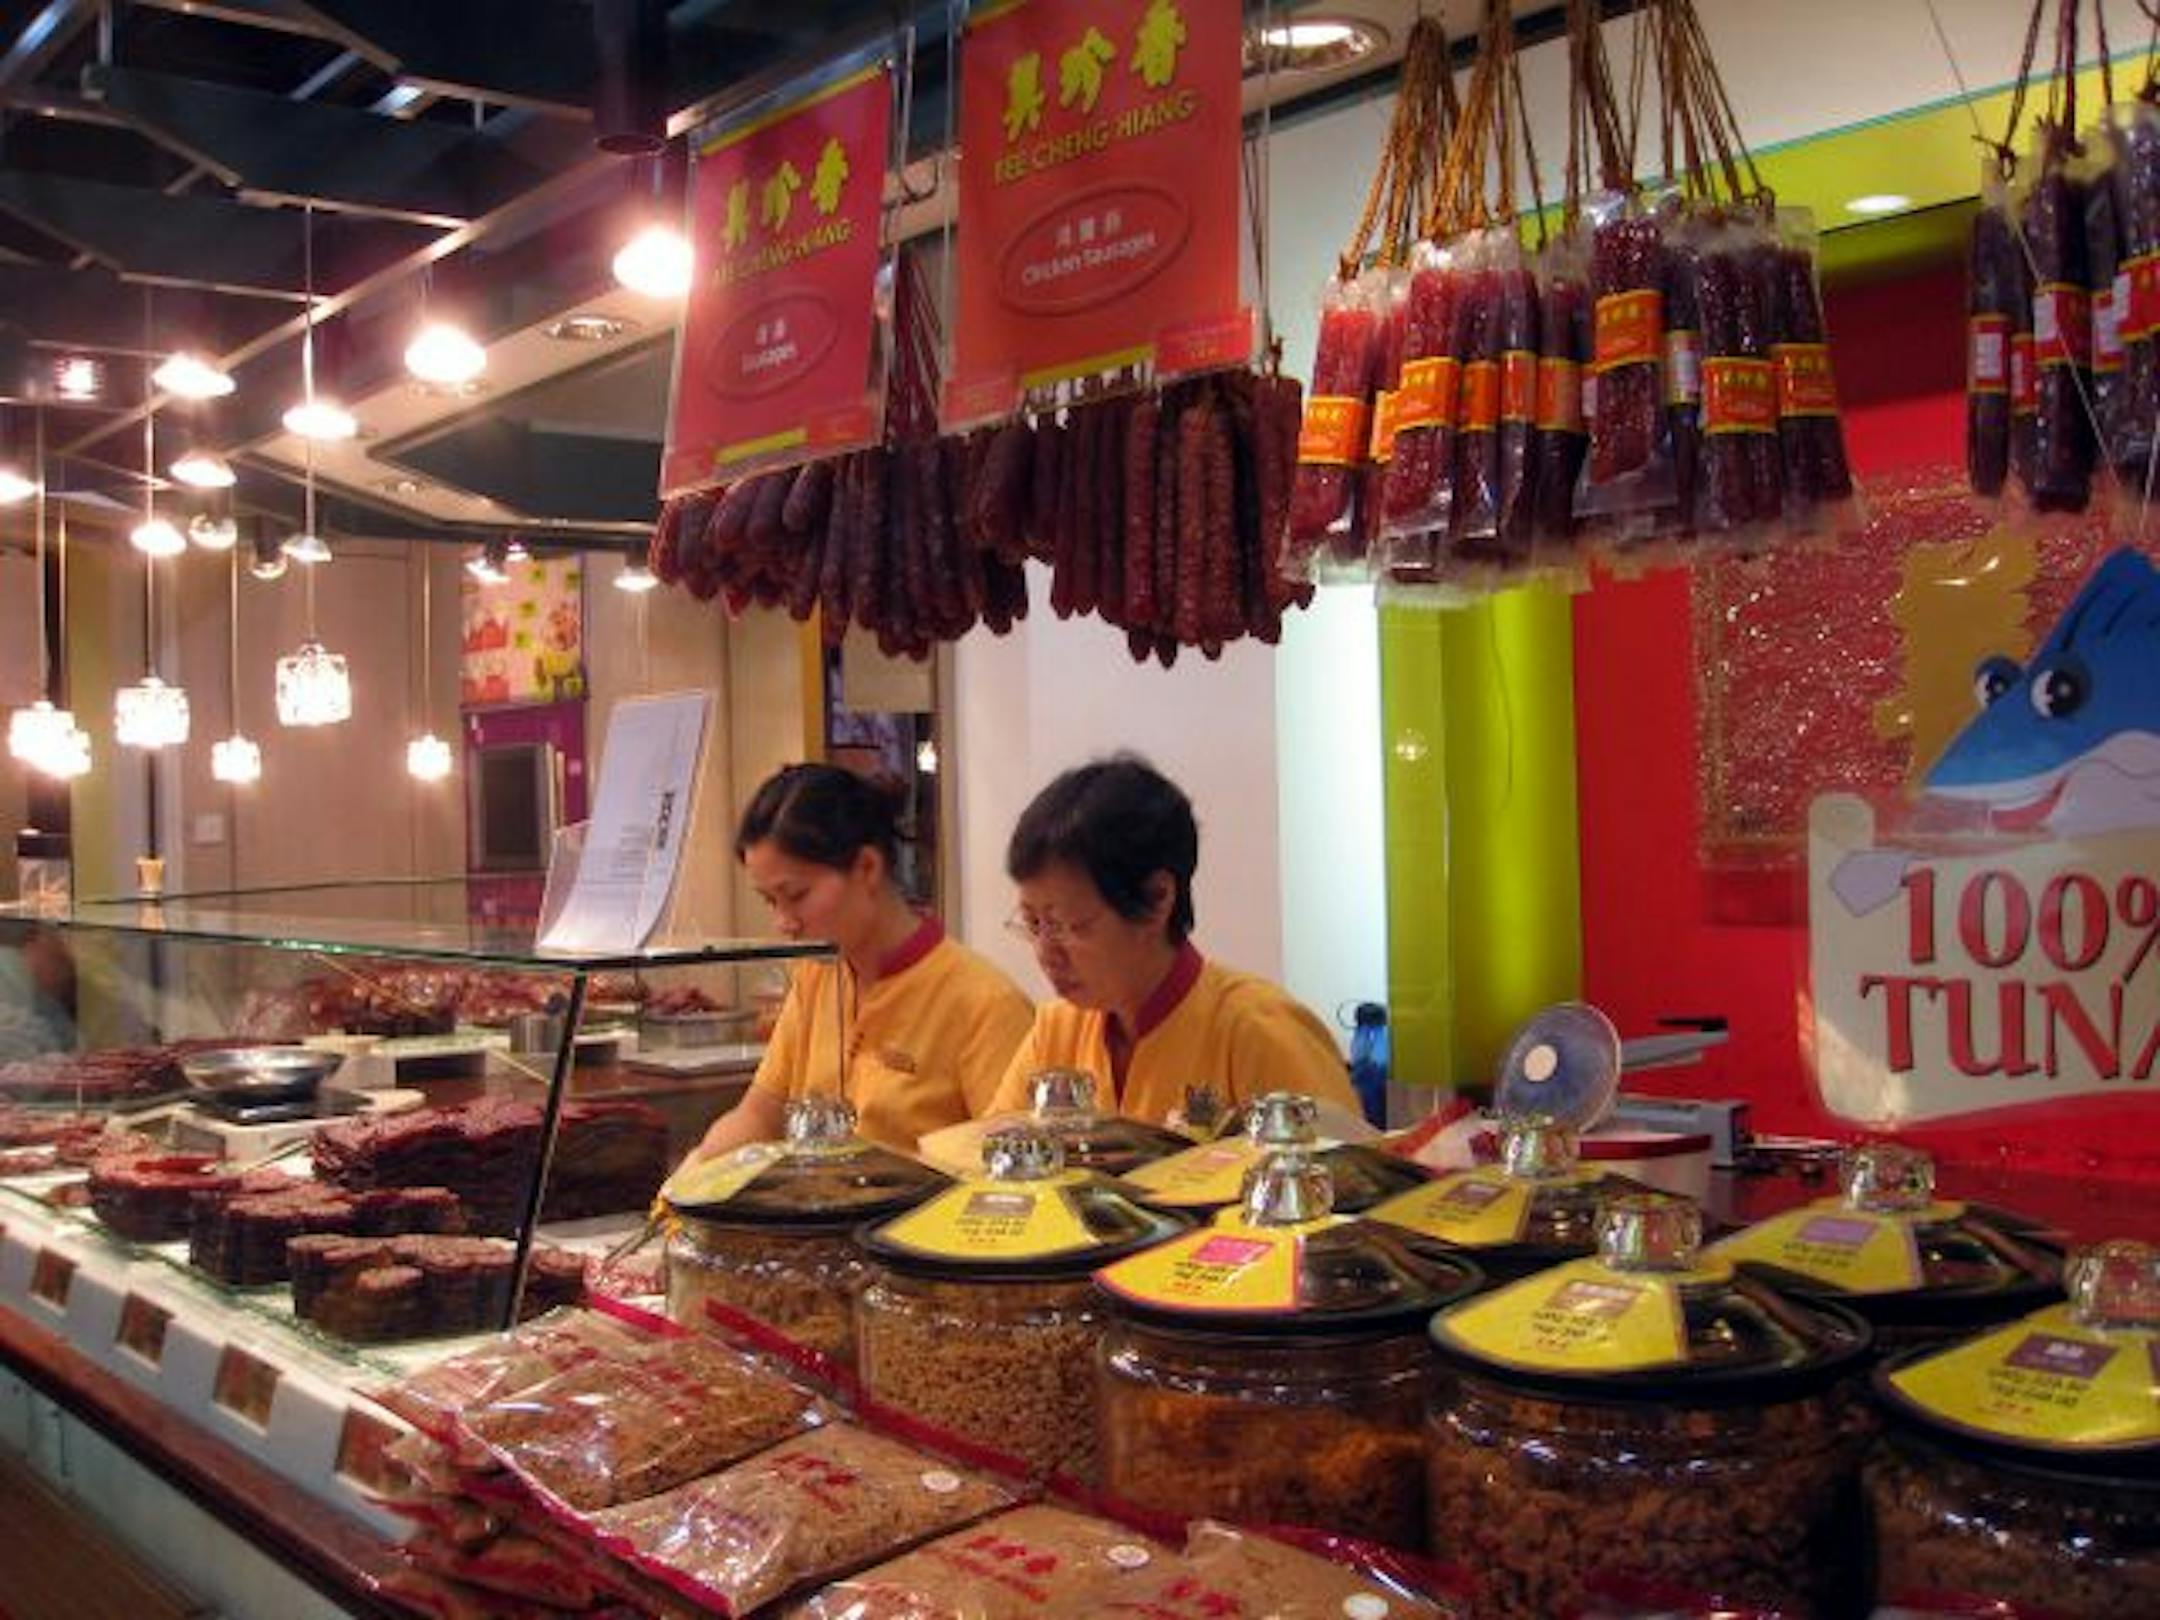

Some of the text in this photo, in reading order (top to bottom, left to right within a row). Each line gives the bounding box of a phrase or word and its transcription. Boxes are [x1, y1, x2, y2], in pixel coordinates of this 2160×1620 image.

[1032, 121, 1110, 170] CHENG
[1112, 88, 1197, 137] HIANG
[1861, 973, 2160, 1080] TUN
